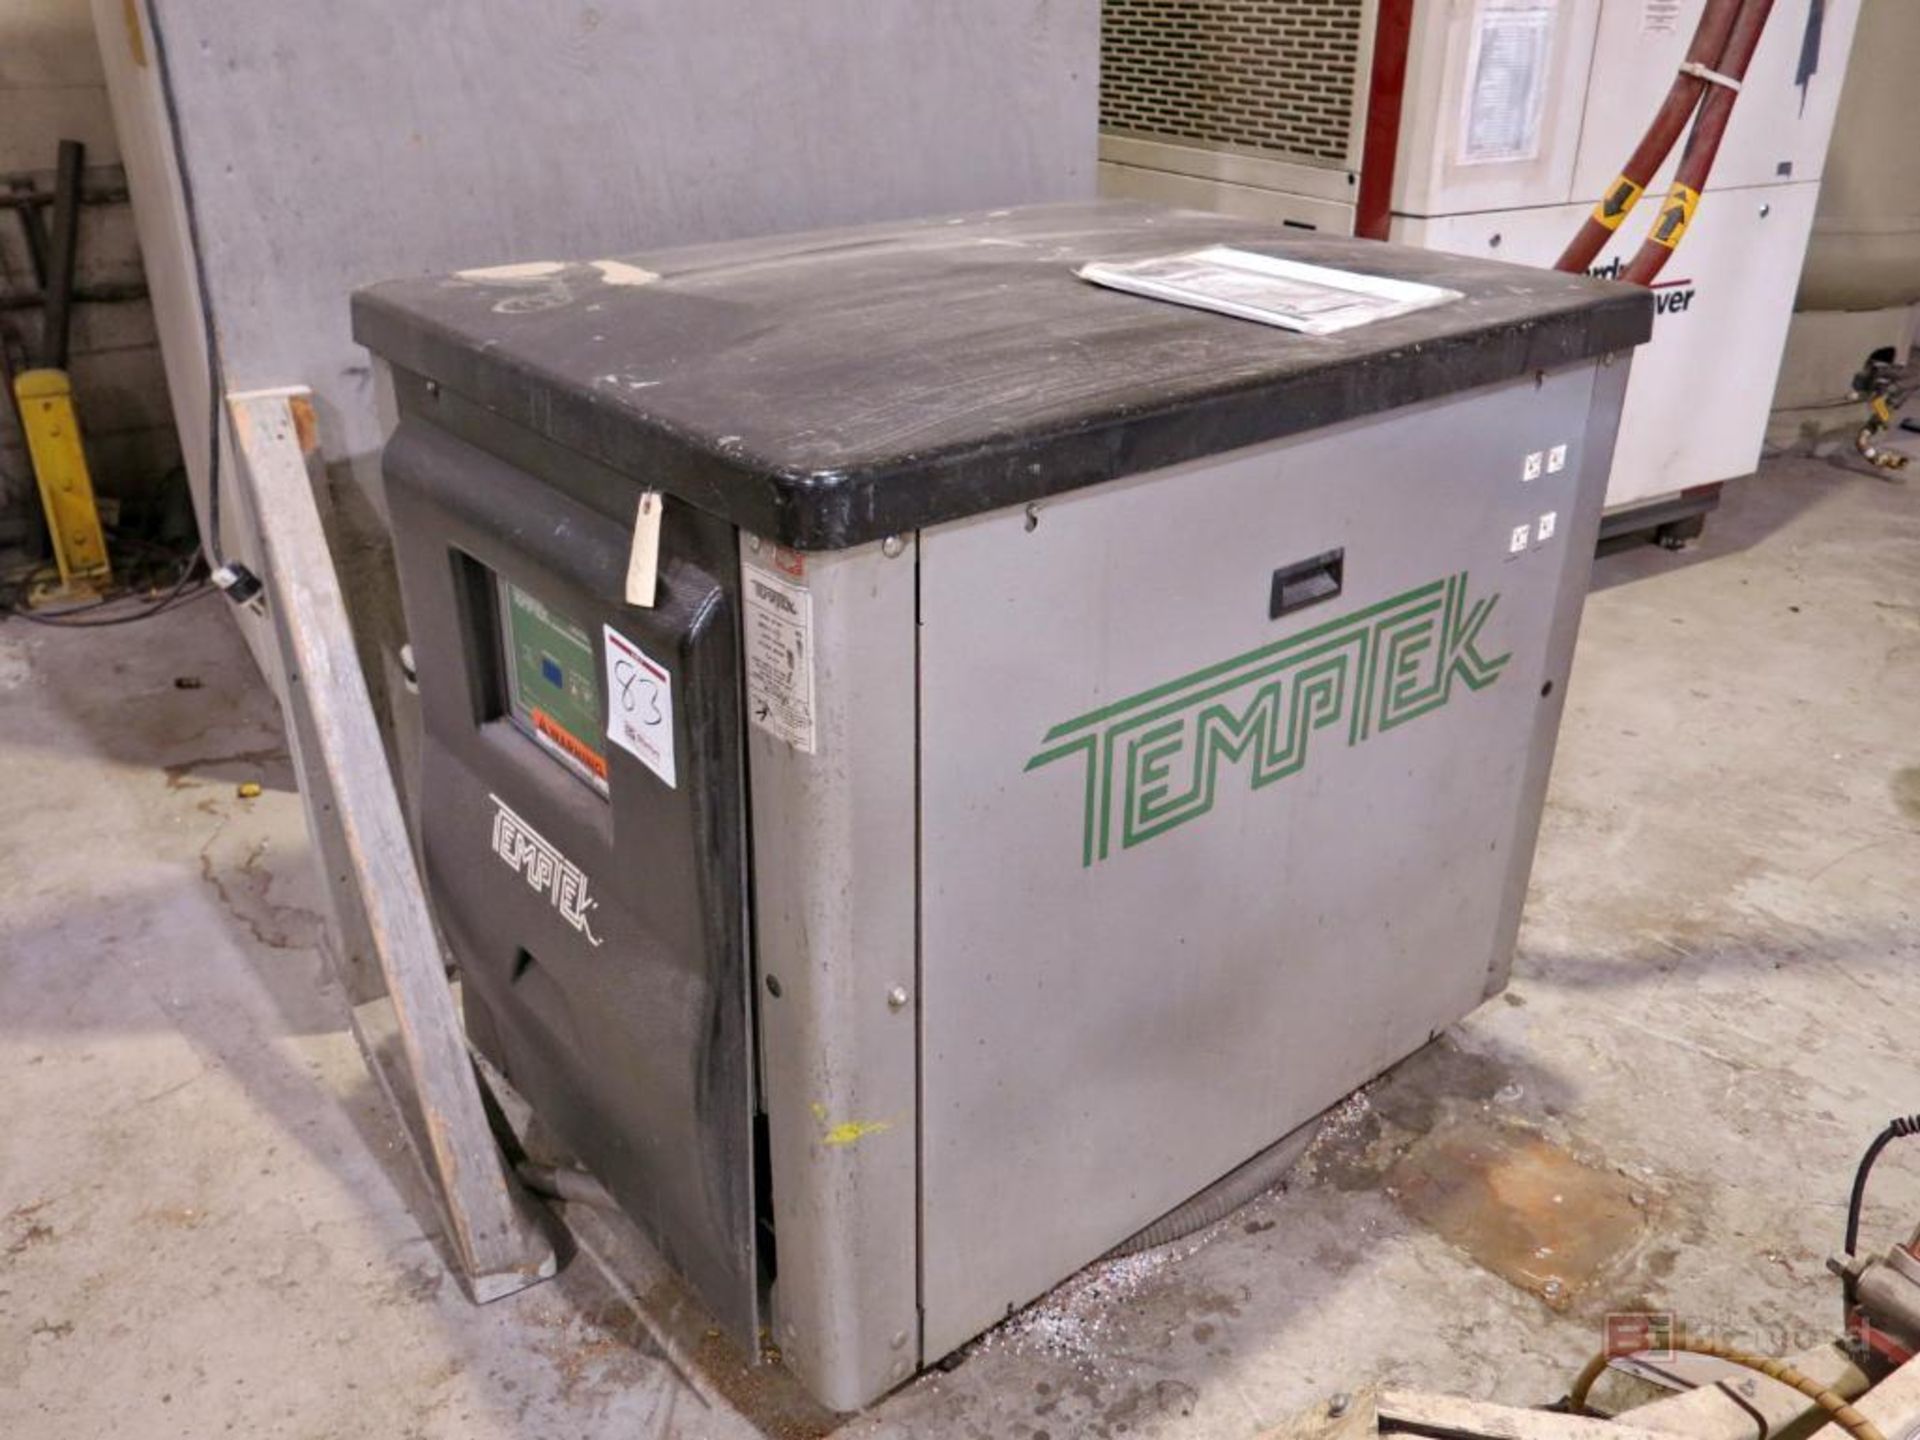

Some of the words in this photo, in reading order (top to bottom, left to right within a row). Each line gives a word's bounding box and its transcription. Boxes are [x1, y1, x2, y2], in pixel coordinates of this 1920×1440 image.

[1656, 290, 1695, 315] ver
[614, 659, 662, 726] 83
[1023, 571, 1513, 868] TEMPTEK
[489, 793, 604, 947] TEMPTEK
